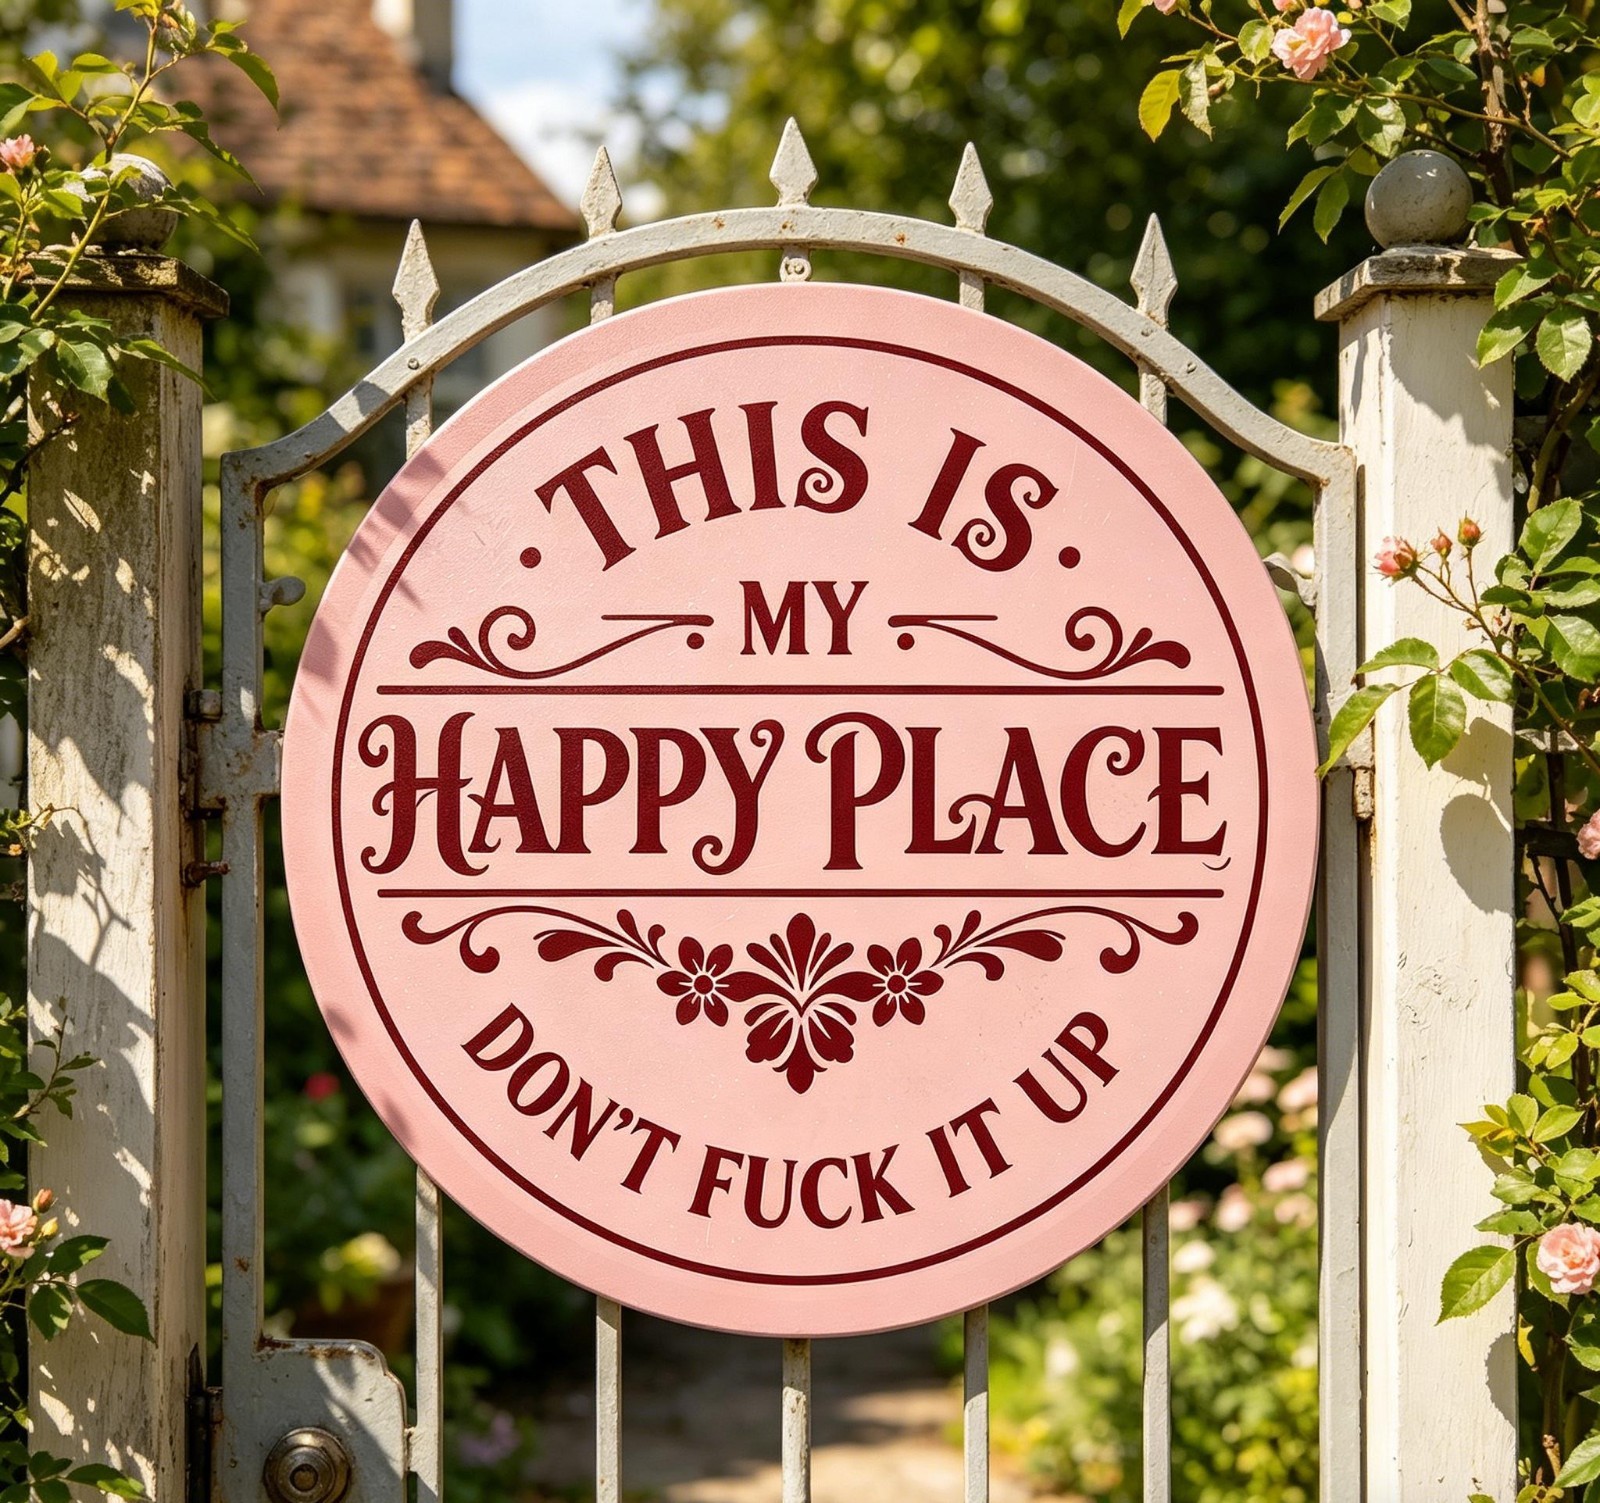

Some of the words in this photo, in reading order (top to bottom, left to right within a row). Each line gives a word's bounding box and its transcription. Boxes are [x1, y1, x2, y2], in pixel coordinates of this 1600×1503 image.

[535, 400, 869, 572] THIS
[907, 427, 1060, 573] IS
[738, 580, 870, 656] MY
[358, 712, 785, 877] HAPPY
[804, 711, 1228, 871] PLACE
[460, 1002, 682, 1195] DON'T
[687, 1143, 916, 1230] FUCK
[925, 1097, 1014, 1199] IT
[1012, 1011, 1121, 1124] UP
